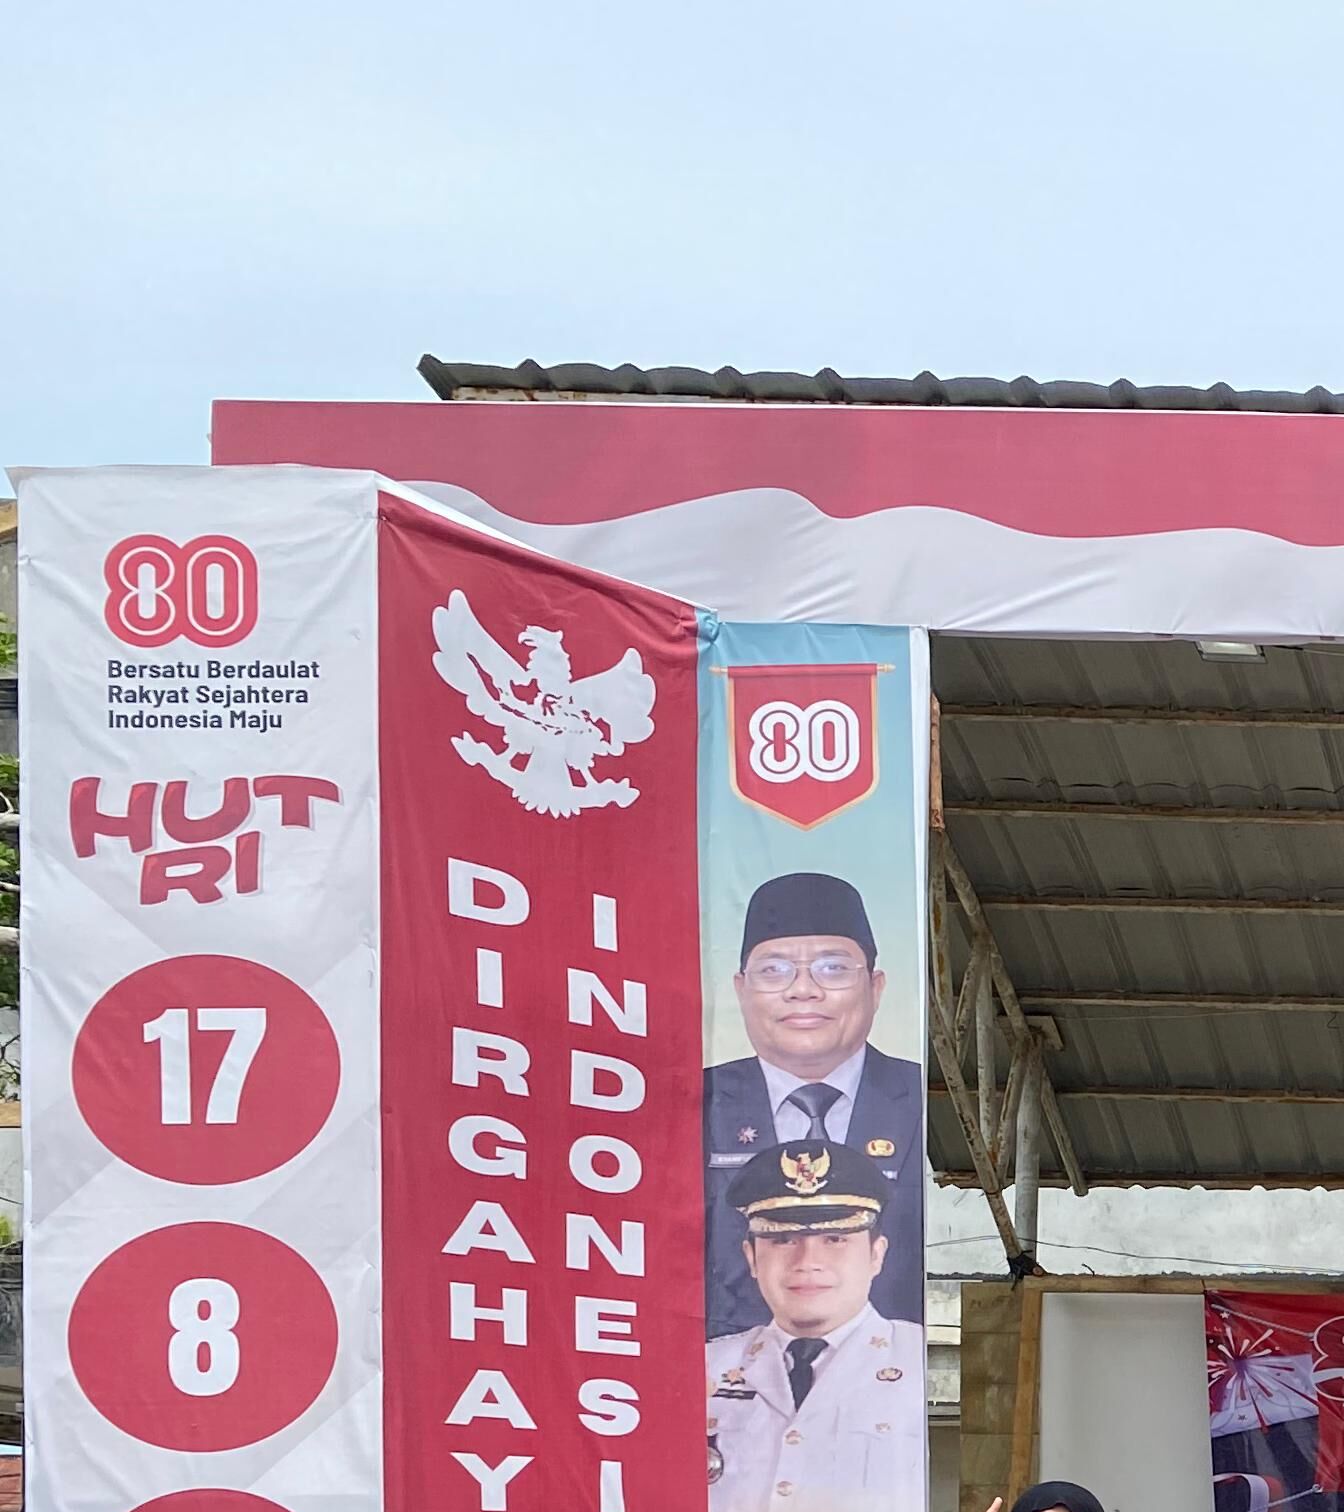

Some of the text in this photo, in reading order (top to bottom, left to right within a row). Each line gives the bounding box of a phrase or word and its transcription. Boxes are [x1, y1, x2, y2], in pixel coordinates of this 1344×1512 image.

[104, 534, 259, 649] 80
[107, 659, 321, 680] Bersatu Berdaulat
[107, 683, 309, 709] Rakyat Sejahtera
[107, 708, 284, 733] Indonesia Maju
[748, 698, 861, 784] 80
[68, 774, 344, 860] HUT
[139, 844, 264, 906] RI
[142, 1007, 267, 1125] 17
[167, 1277, 241, 1397] 8
